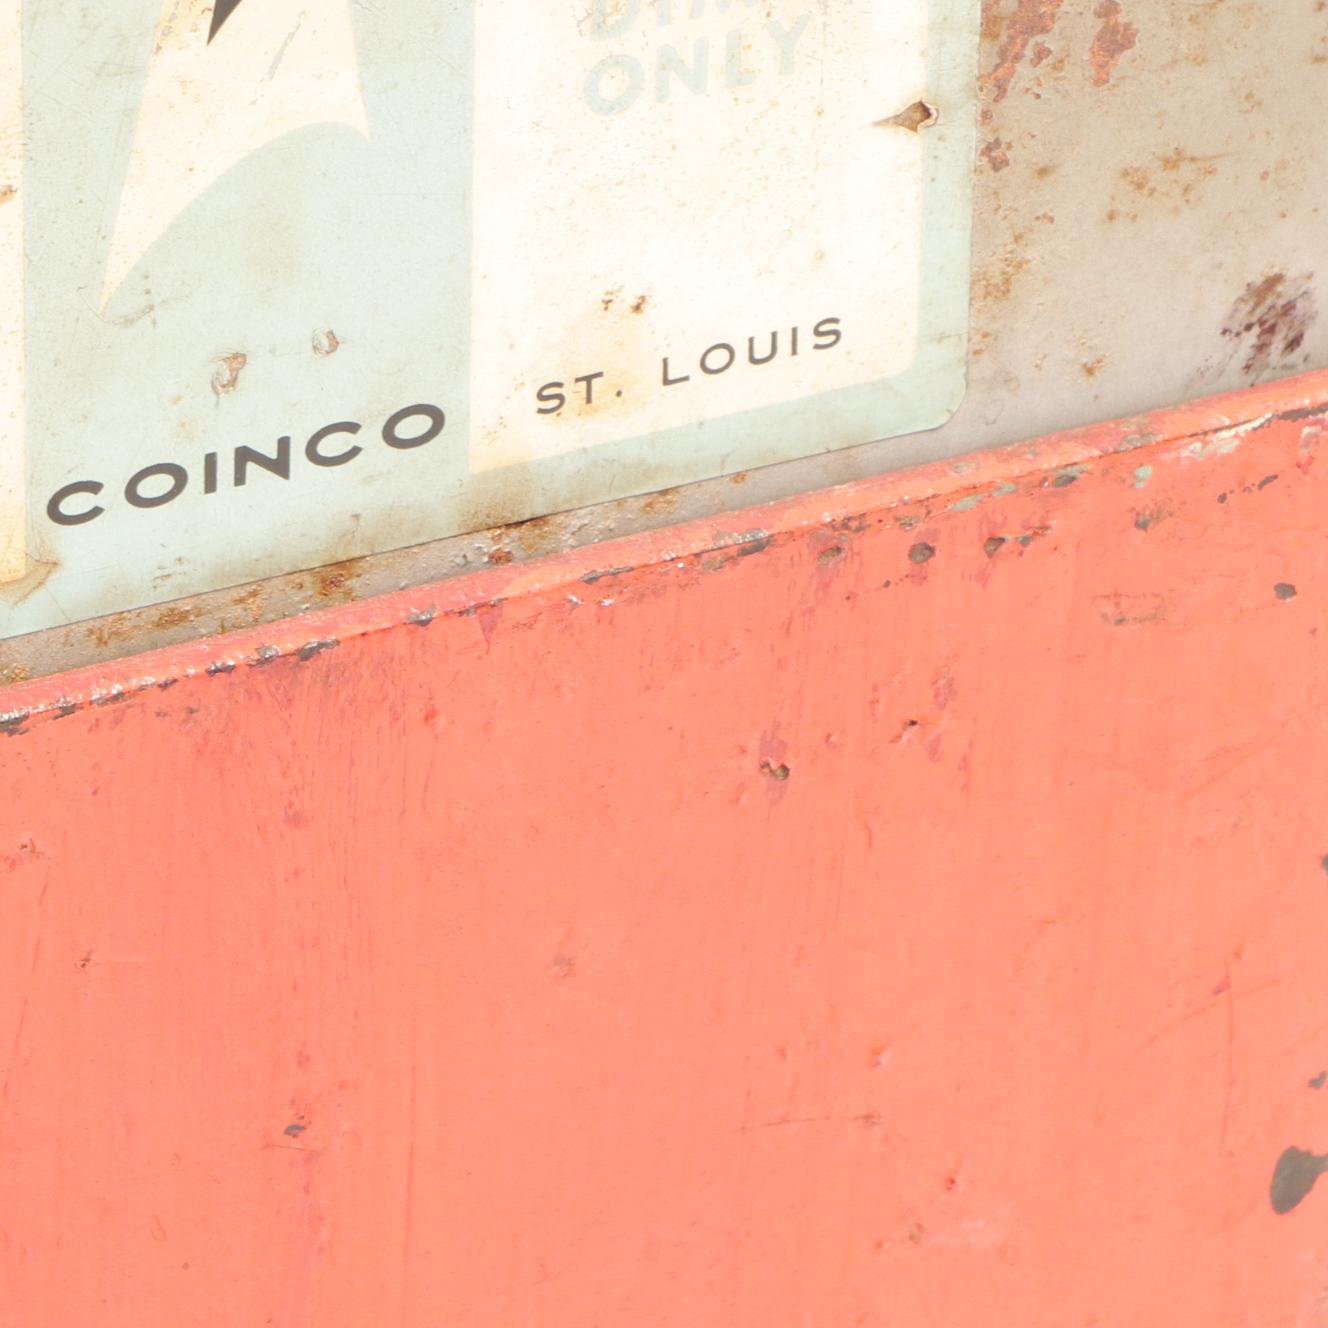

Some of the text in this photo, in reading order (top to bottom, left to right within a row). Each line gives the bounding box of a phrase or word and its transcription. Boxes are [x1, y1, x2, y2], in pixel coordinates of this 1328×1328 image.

[582, 14, 813, 116] ONLY
[45, 403, 446, 526] COINCO
[535, 371, 623, 415] ST.
[660, 317, 843, 388] LOUIS
